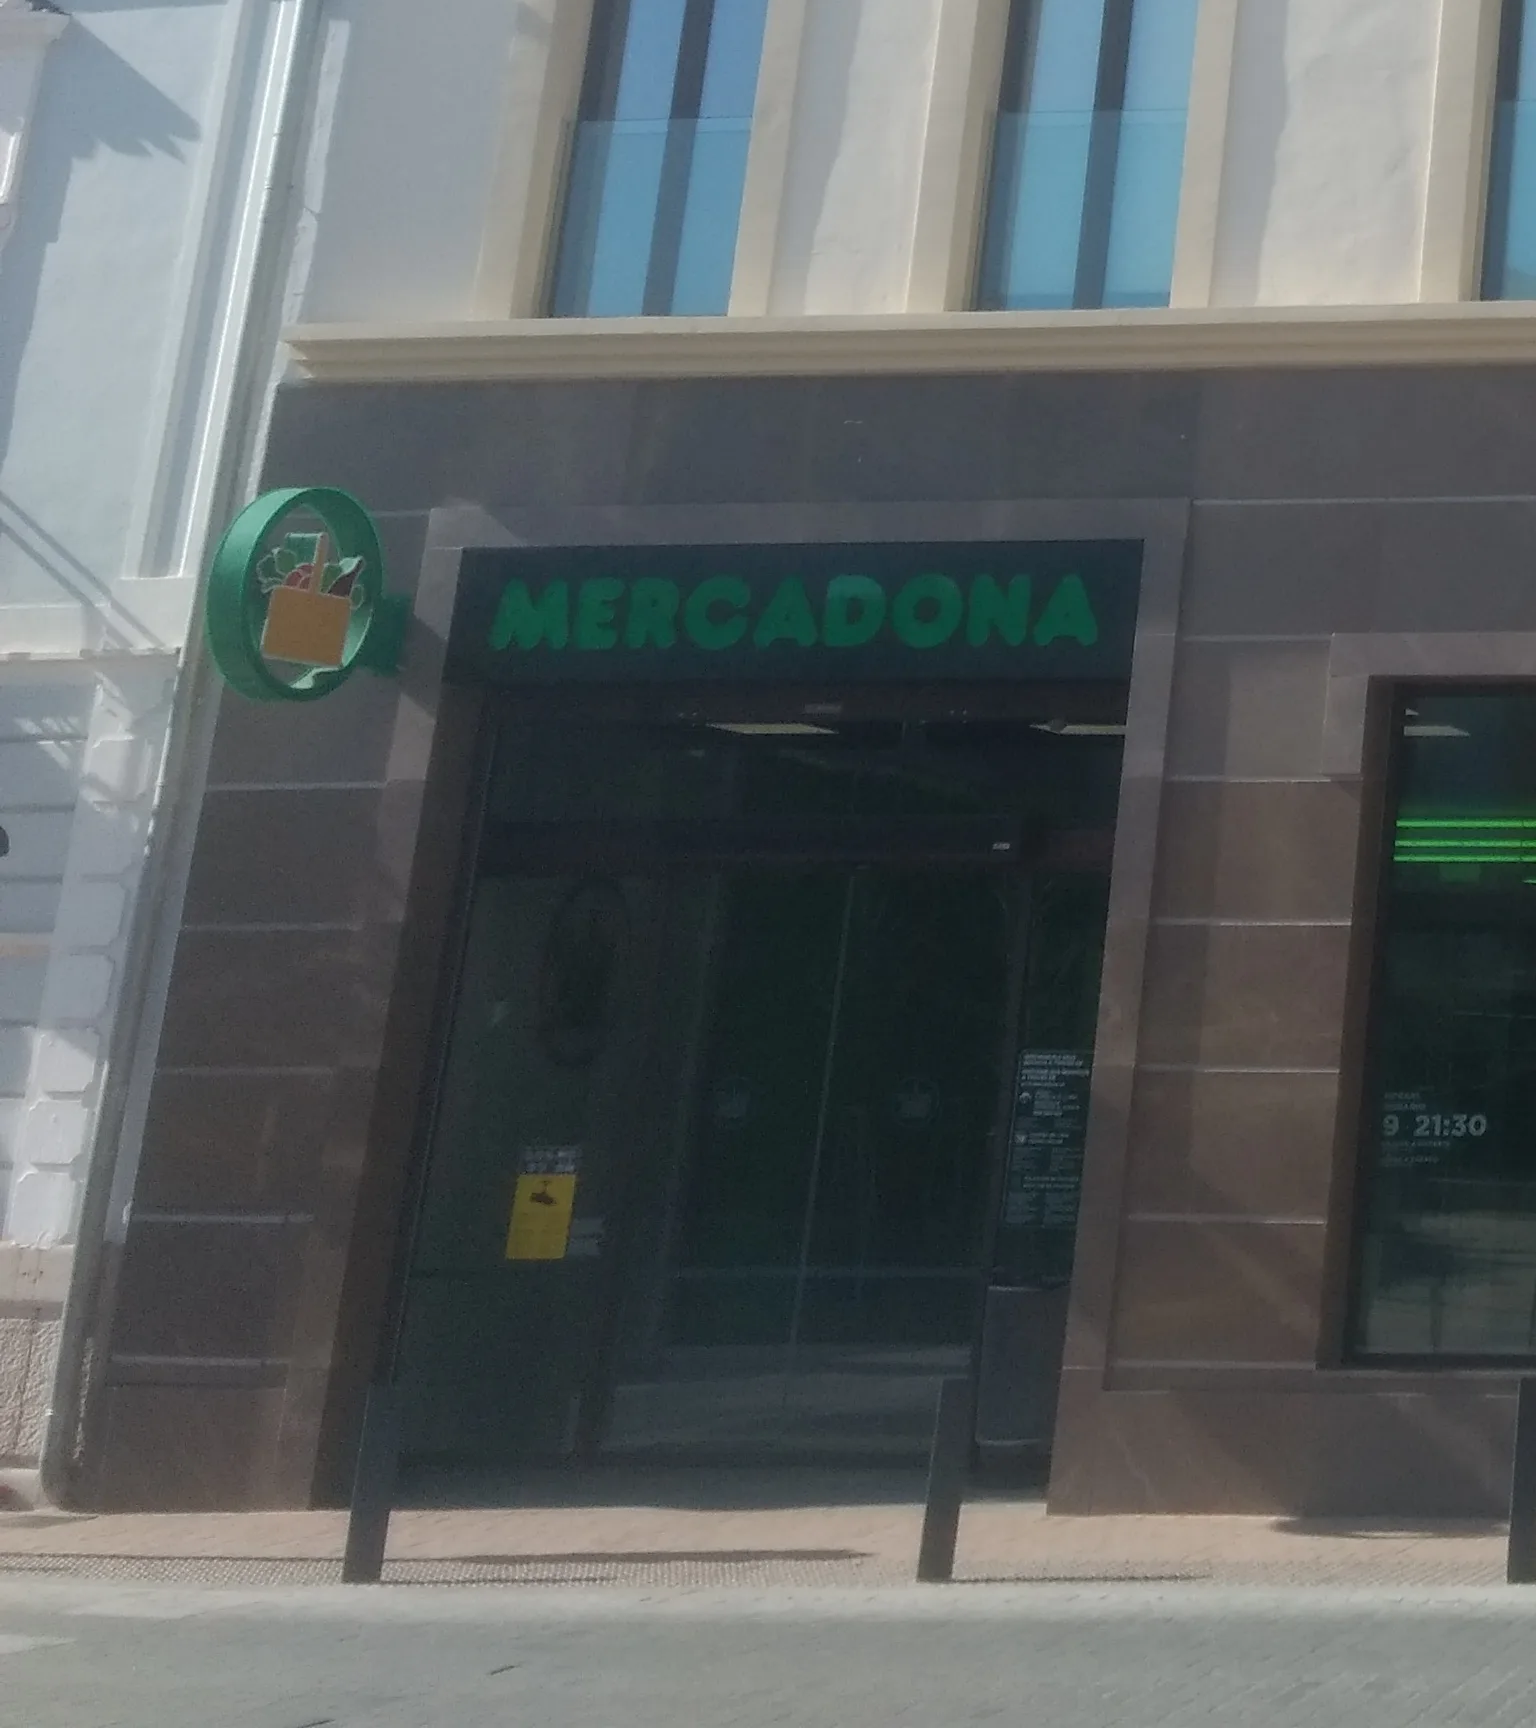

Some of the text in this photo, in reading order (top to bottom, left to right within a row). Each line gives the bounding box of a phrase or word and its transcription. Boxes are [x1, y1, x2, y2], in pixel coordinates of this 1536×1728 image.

[490, 574, 1099, 651] MERCADONA
[1382, 1113, 1487, 1137] 9 21:30
